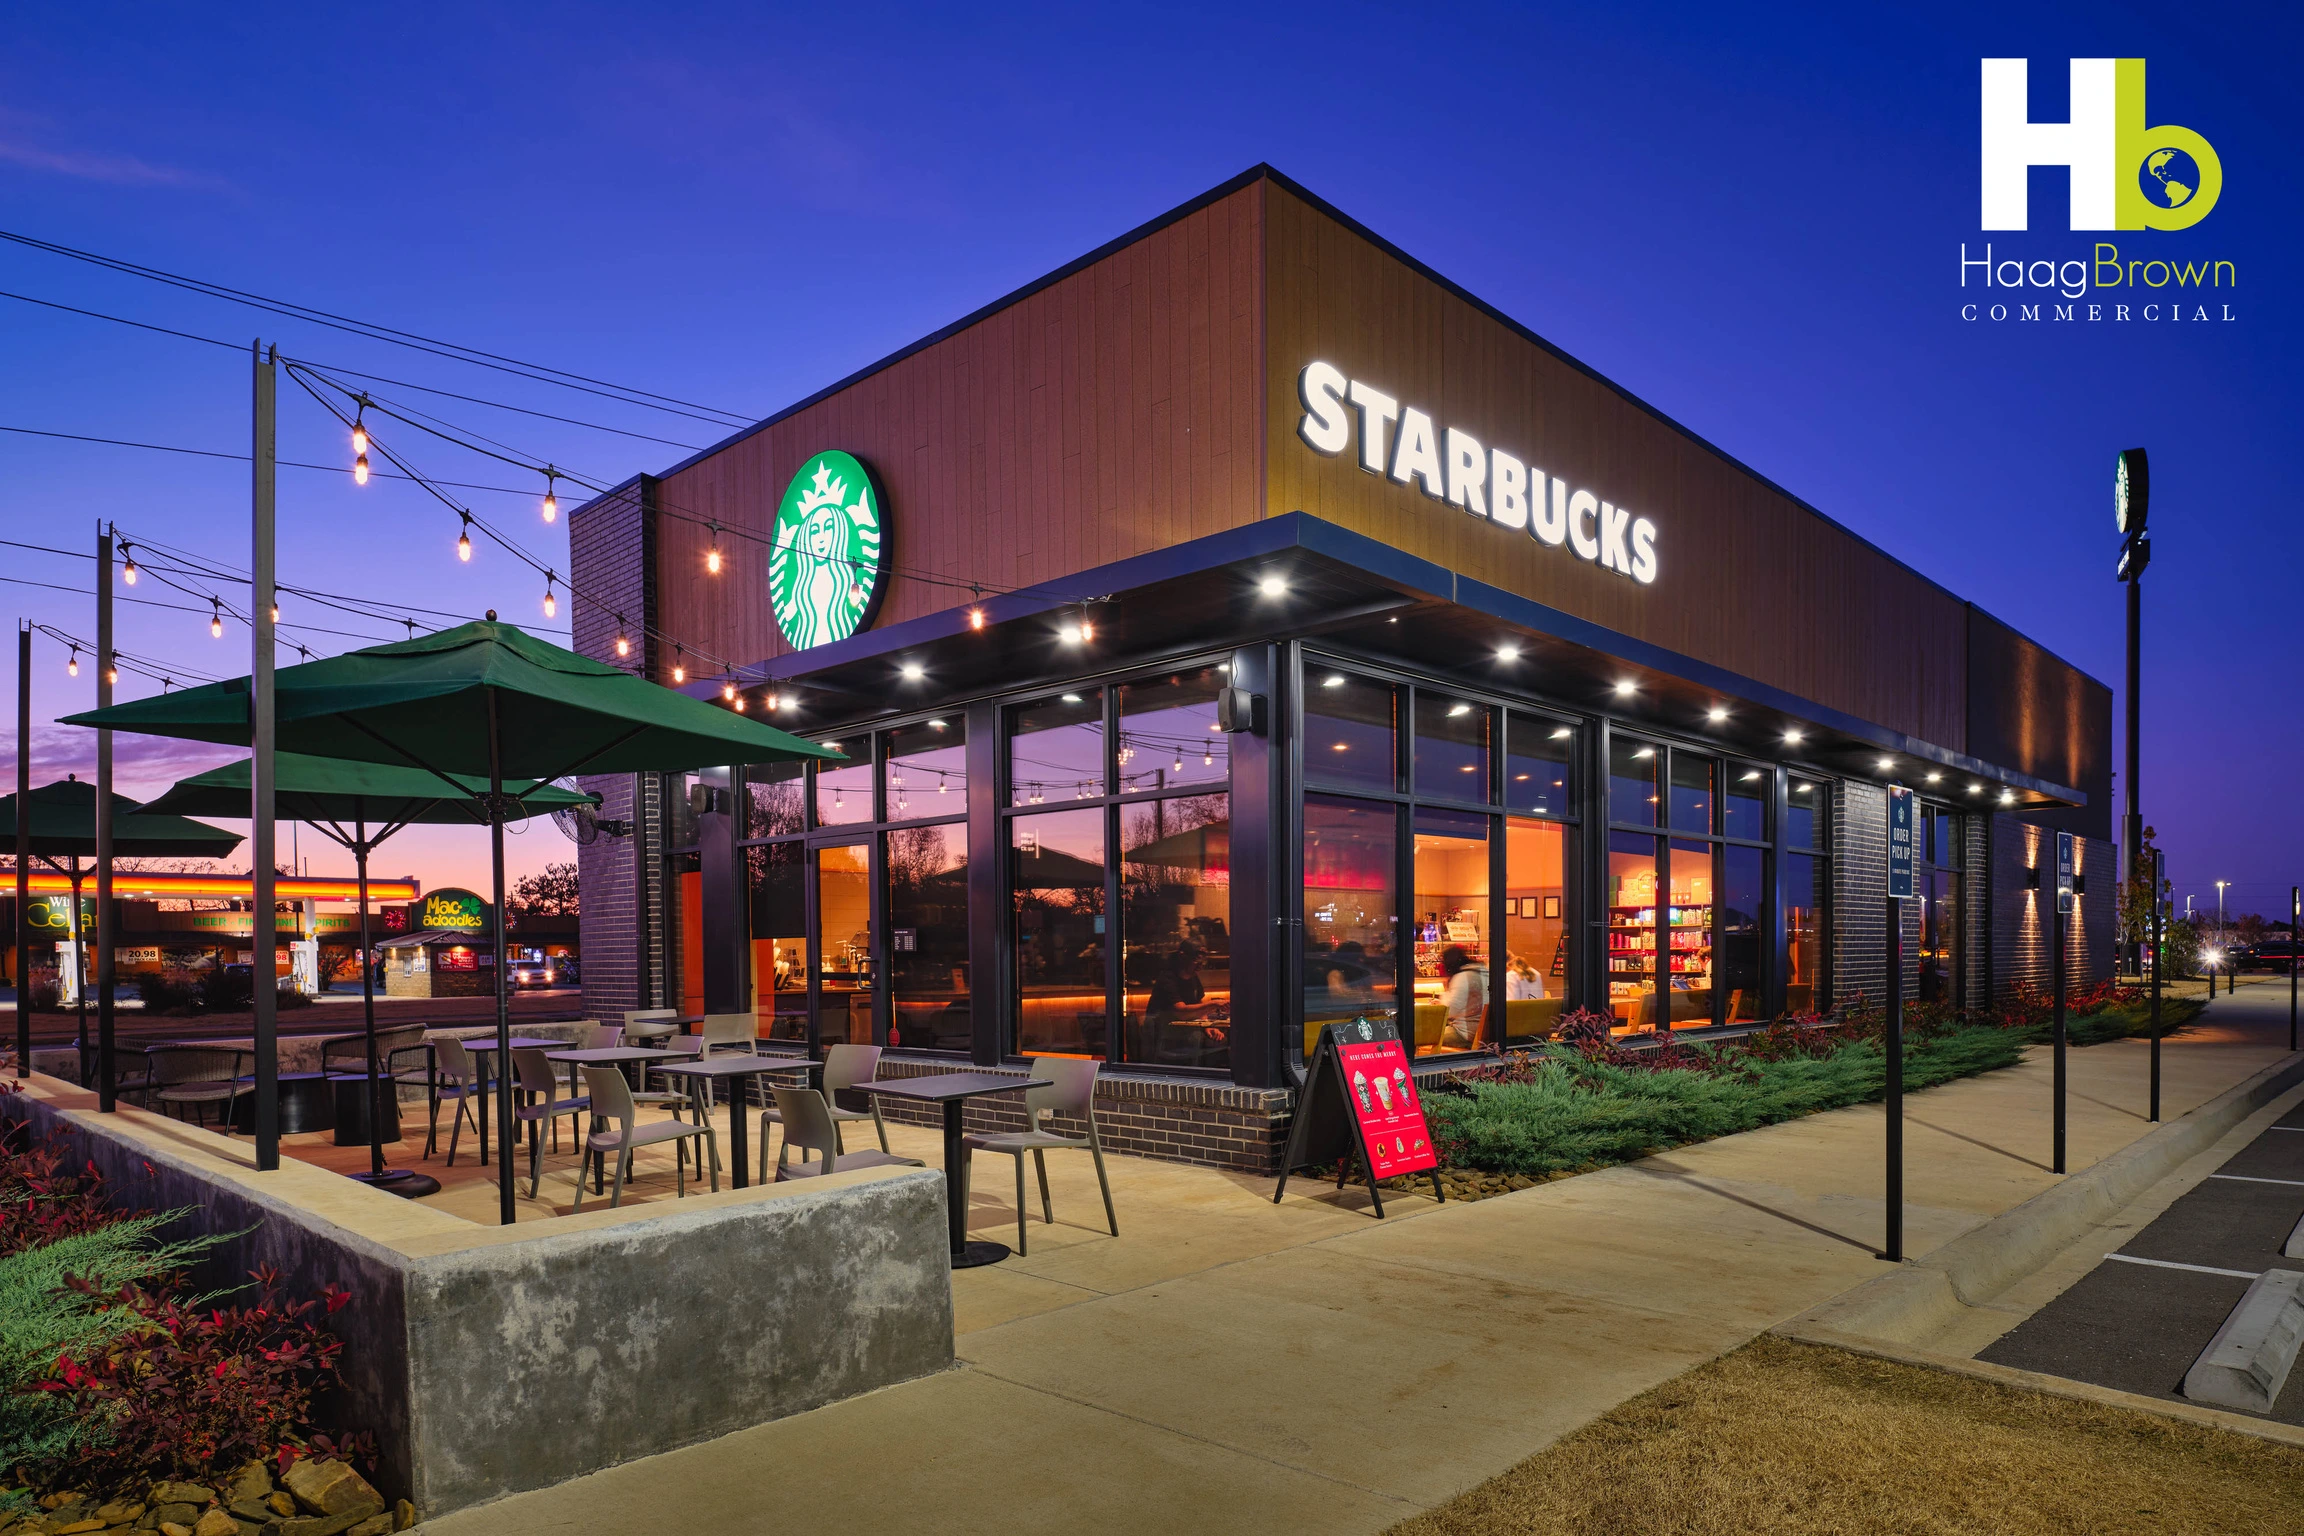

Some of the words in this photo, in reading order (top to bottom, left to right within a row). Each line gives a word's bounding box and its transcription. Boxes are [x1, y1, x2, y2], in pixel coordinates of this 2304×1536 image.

[1298, 361, 1659, 584] STARBUCKS
[1893, 827, 1909, 842] ORDER
[1892, 845, 1903, 859] PICK
[1903, 846, 1910, 860] UP
[2060, 862, 2070, 873] ORDER
[193, 917, 227, 927] BEER
[238, 917, 254, 927] FIN
[315, 917, 350, 927] PIRITS
[423, 913, 483, 927] adoodles
[128, 950, 156, 958] 20.98
